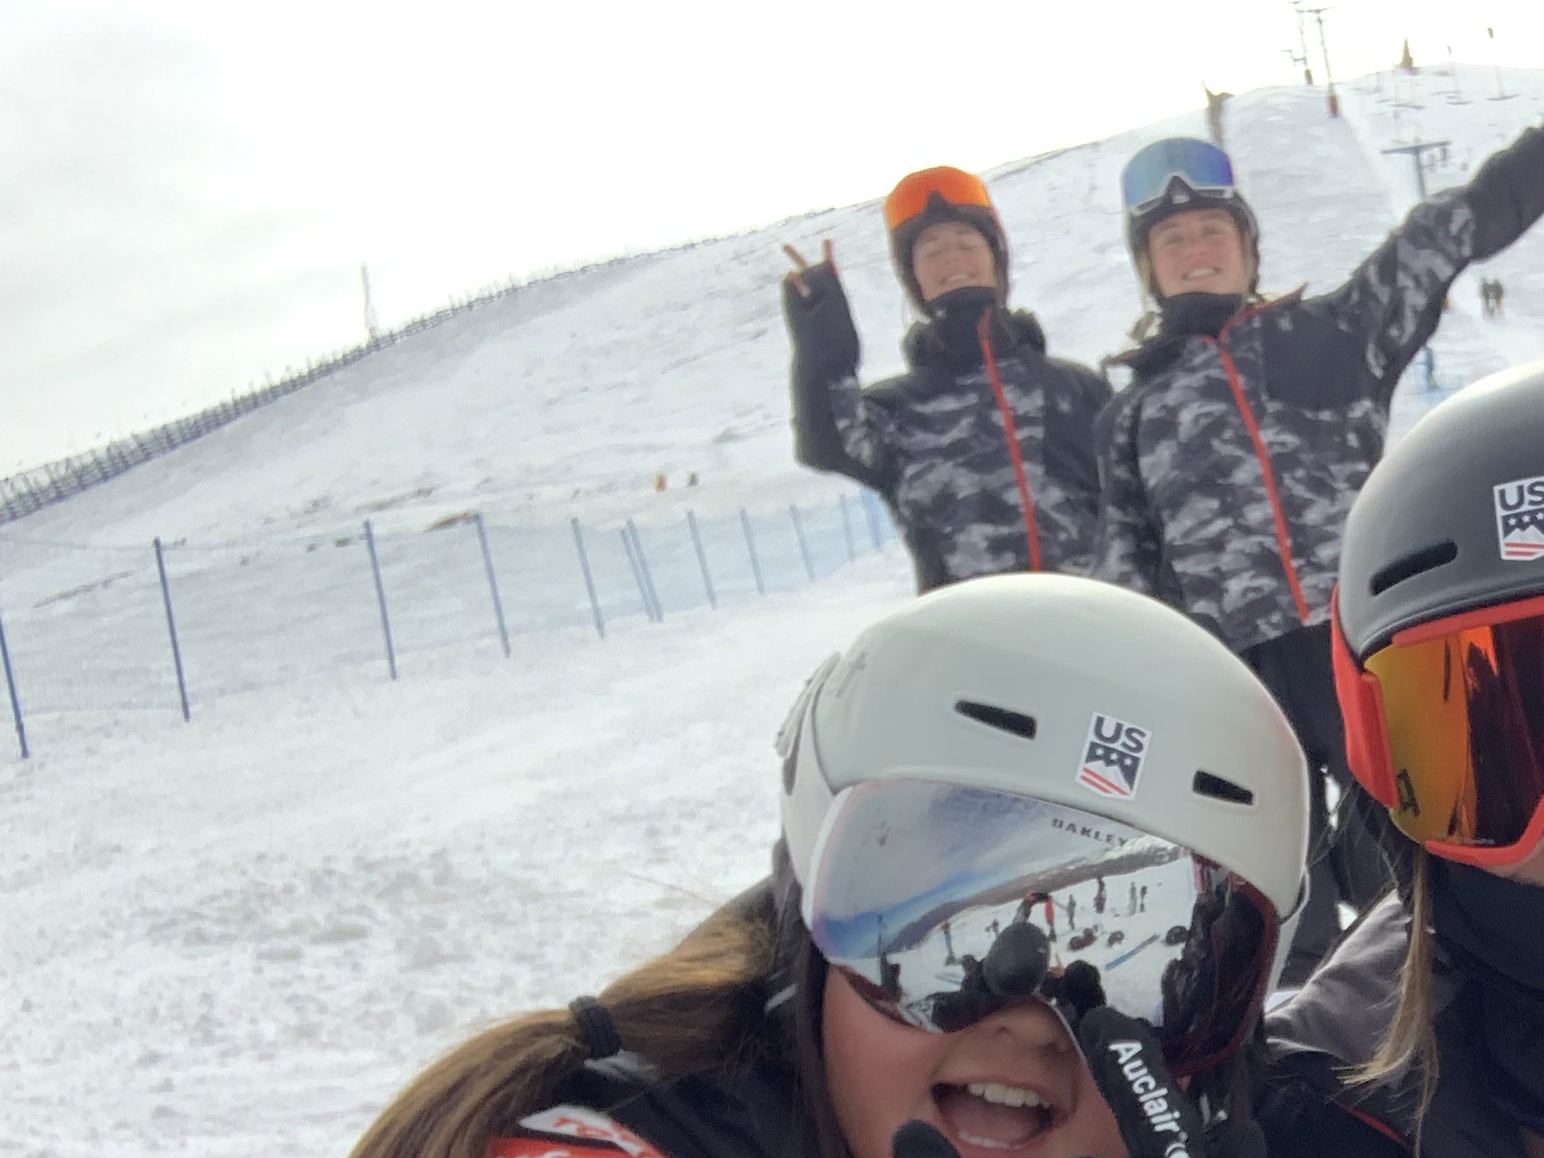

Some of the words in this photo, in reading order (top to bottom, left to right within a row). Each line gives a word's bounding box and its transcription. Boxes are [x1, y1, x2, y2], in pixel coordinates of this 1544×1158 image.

[1093, 715, 1147, 754] US
[1051, 818, 1129, 846] OAKLEY
[1108, 1040, 1180, 1132] Auclair
